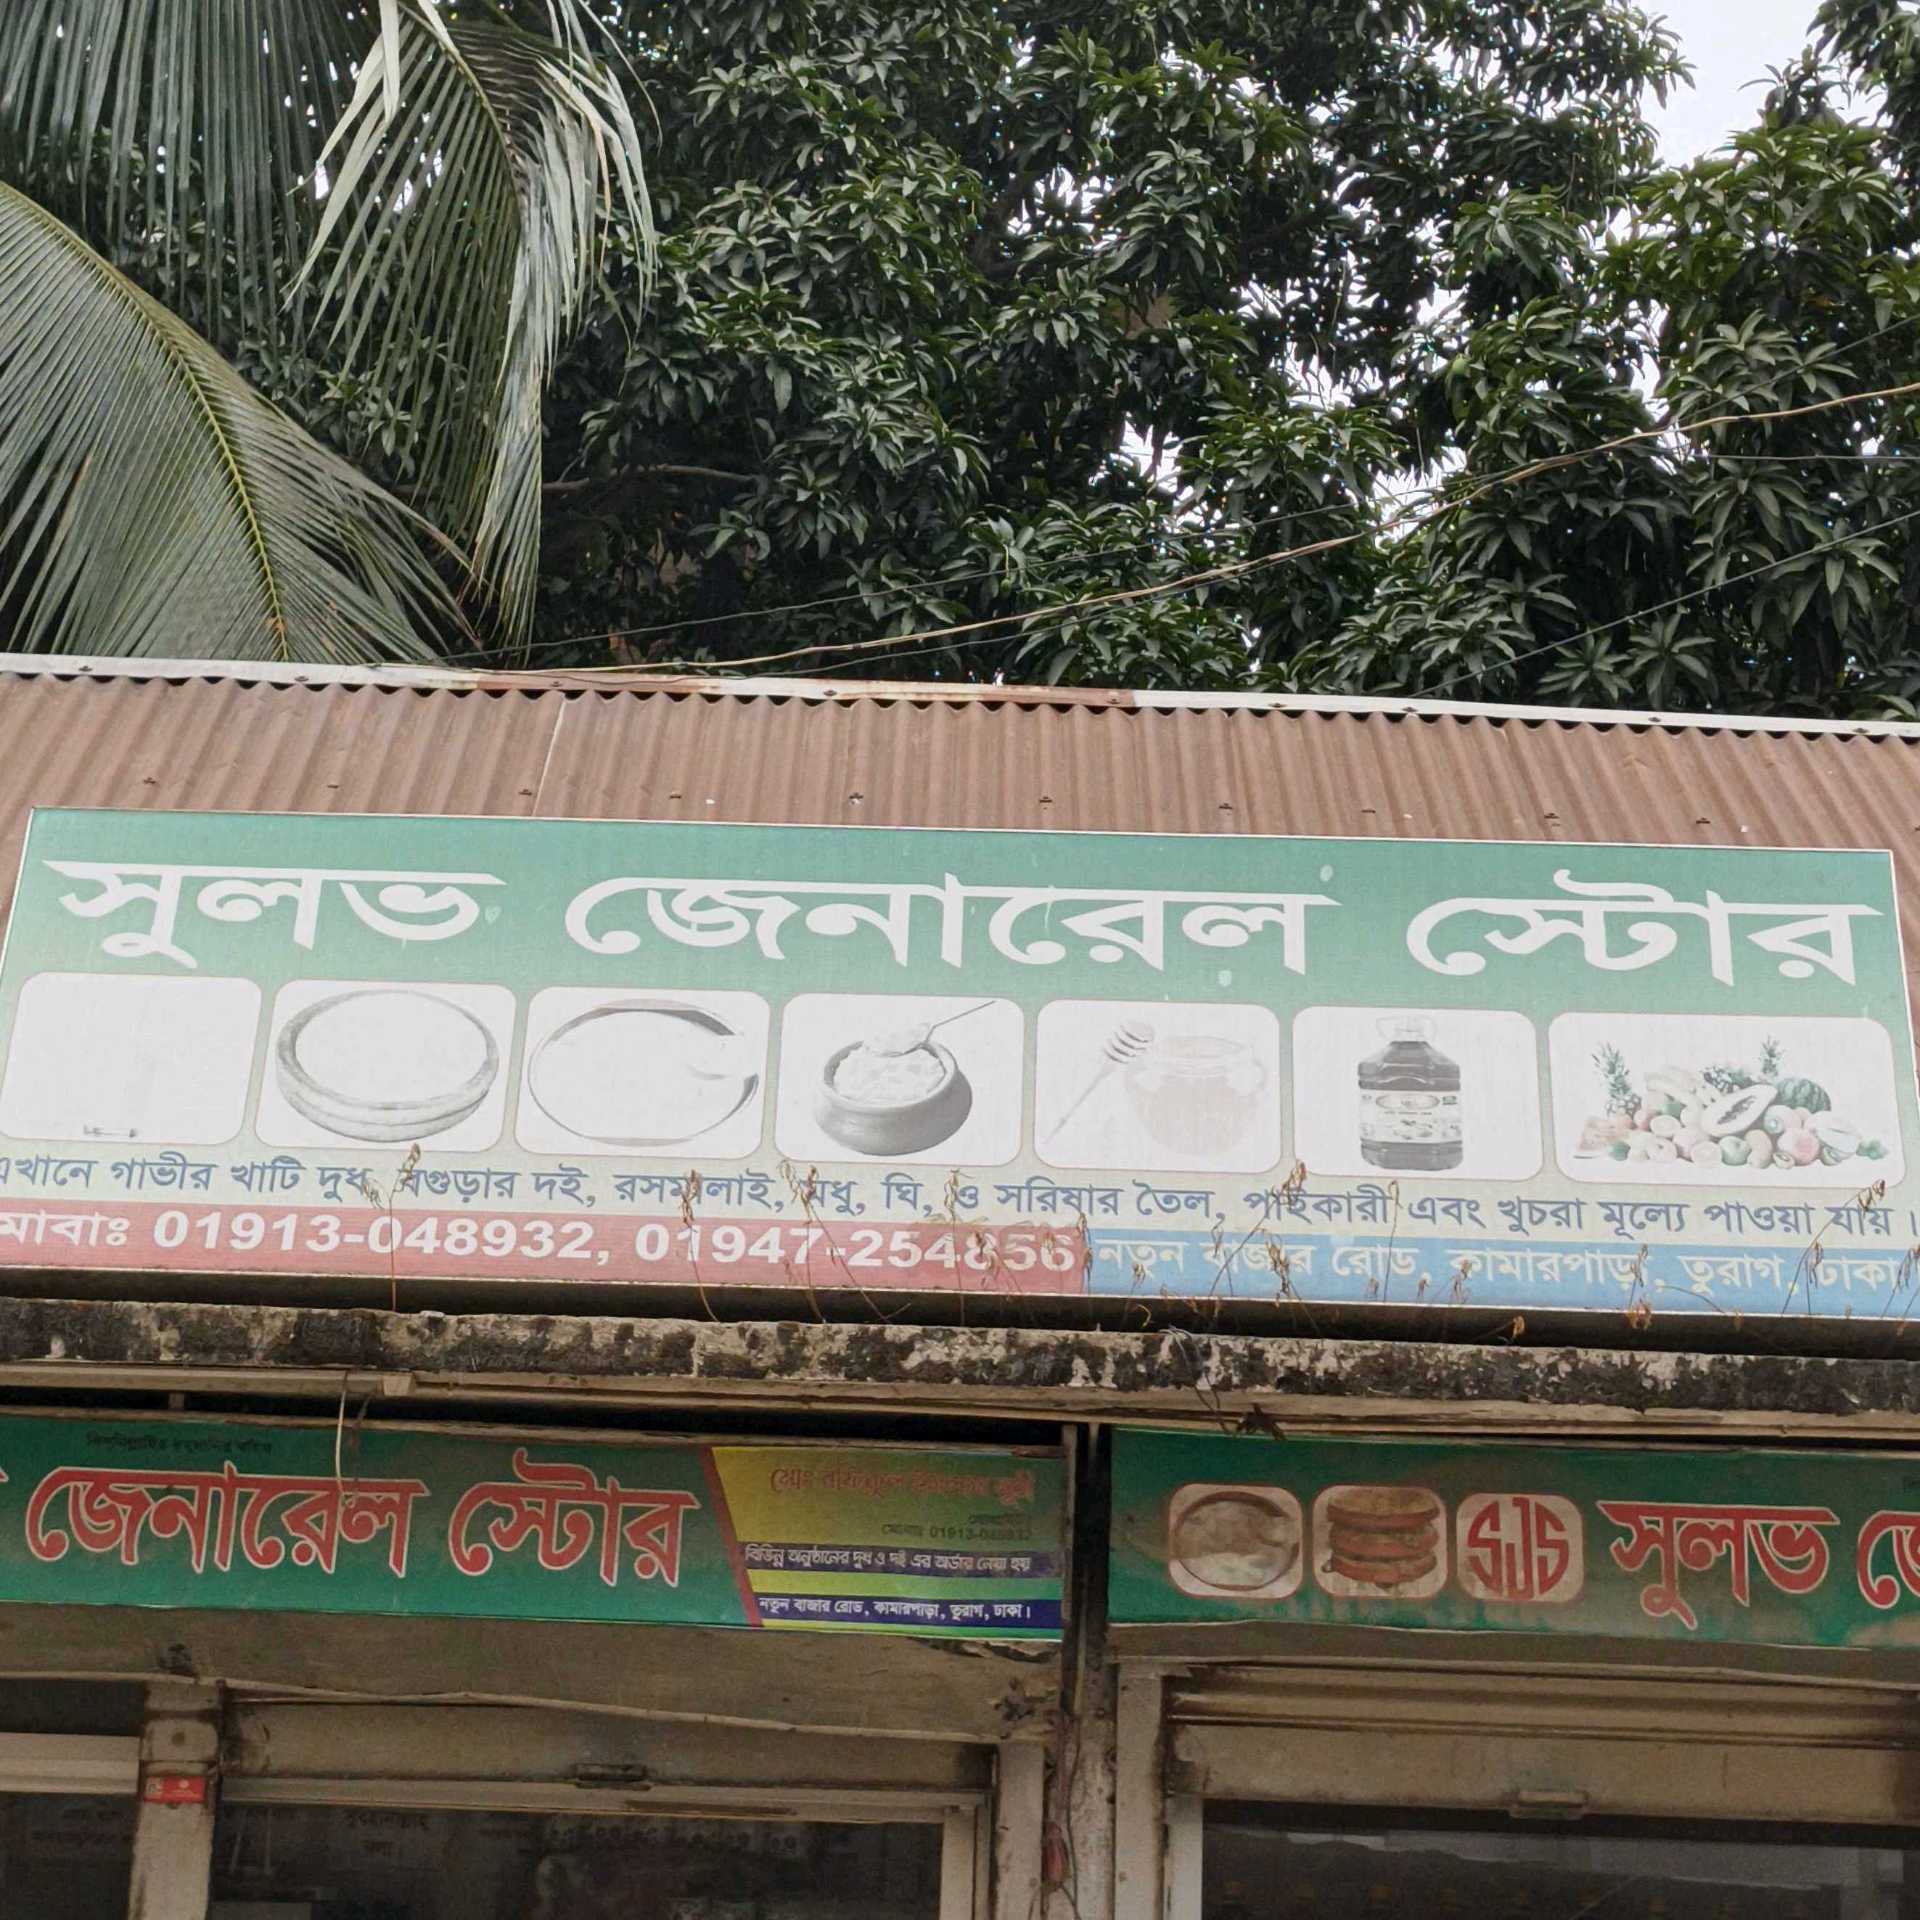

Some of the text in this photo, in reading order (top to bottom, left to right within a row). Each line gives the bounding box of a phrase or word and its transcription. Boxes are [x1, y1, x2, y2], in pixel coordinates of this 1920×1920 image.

[42, 860, 1885, 986] সুলভ জেনারেল স্টোর
[111, 1151, 218, 1190] গাভীর
[231, 1155, 306, 1193] খাটি
[395, 1168, 521, 1203] বগুড়ার
[532, 1163, 595, 1208] দই,
[613, 1169, 784, 1213] রসমালাই,
[881, 1172, 932, 1217] ঘি,
[955, 1184, 980, 1208] ও
[993, 1175, 1124, 1215] সরিষার
[1408, 1196, 1487, 1229] এবং
[1497, 1196, 1587, 1236] খুচরা
[1597, 1200, 1691, 1240] মূল্যে
[1703, 1201, 1816, 1235] পাওয়া
[153, 1210, 610, 1265] 01913-048932,
[635, 1223, 1075, 1273] 01947-254856
[25, 1448, 698, 1588] জেনারেল স্টোর
[1466, 1496, 1571, 1600] SJS
[1596, 1500, 1840, 1630] সুলভ
